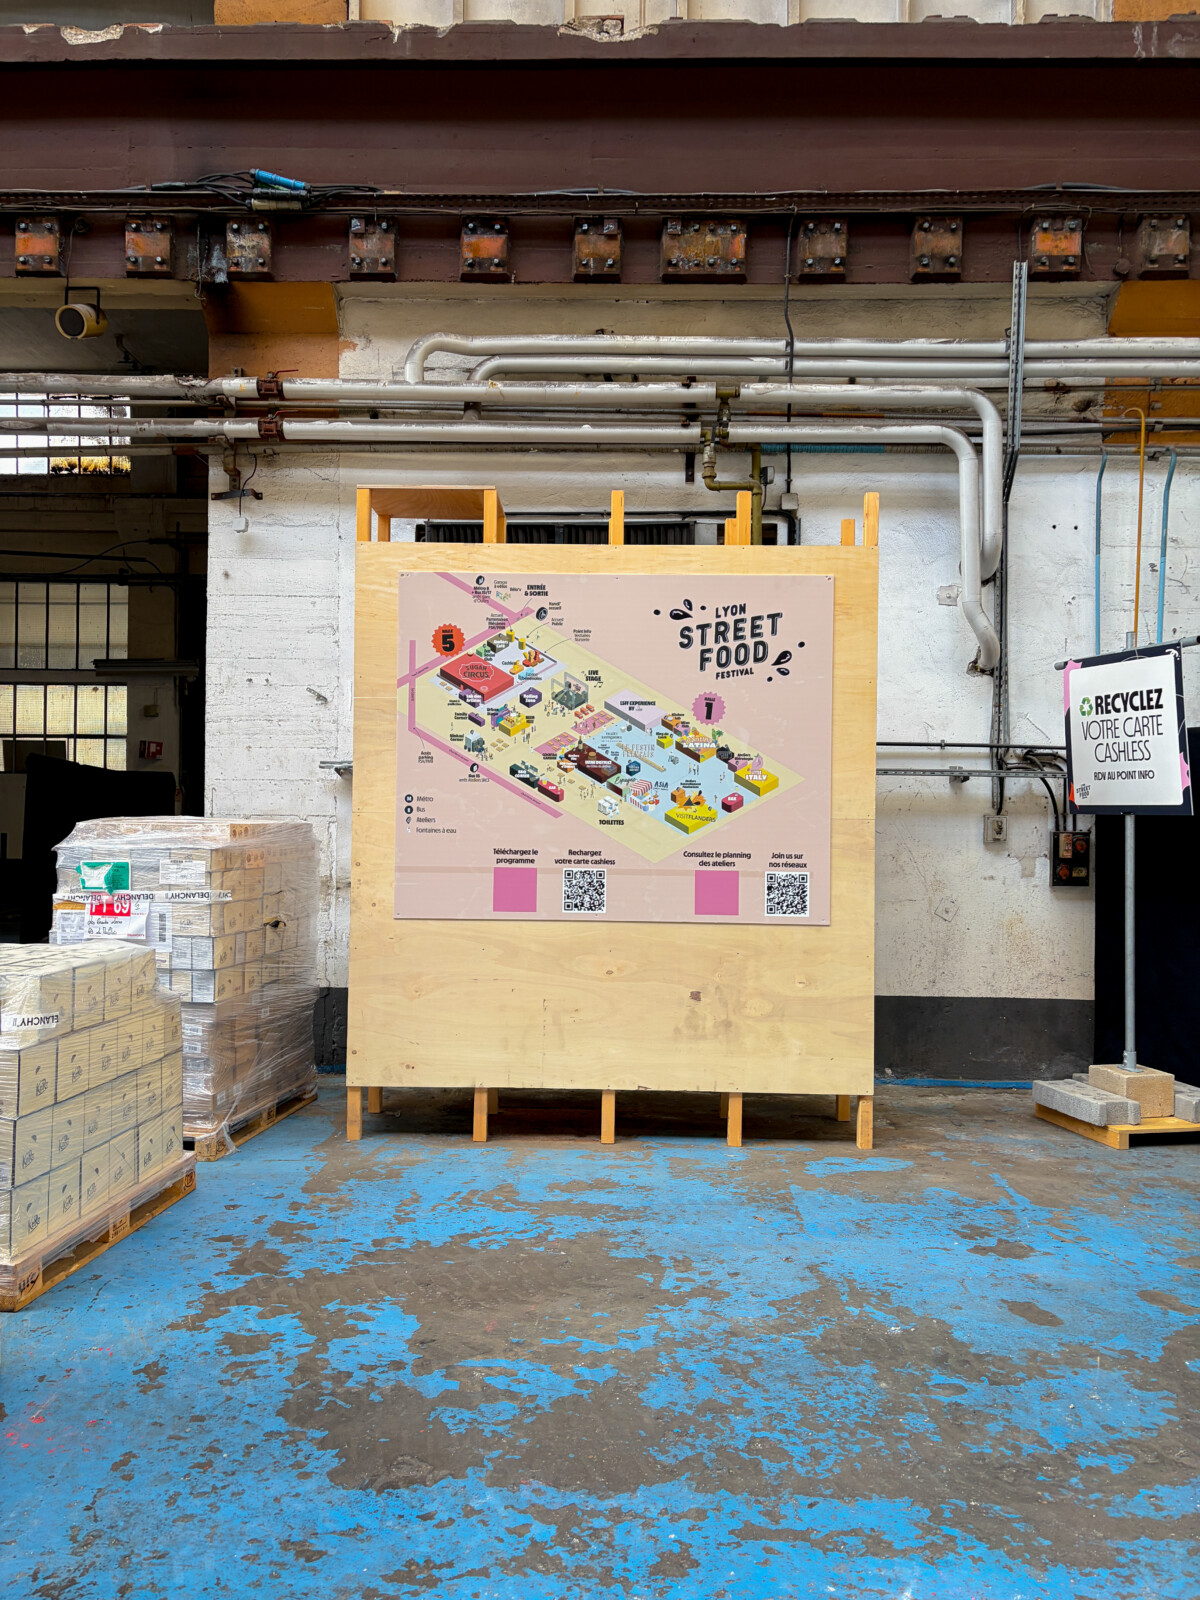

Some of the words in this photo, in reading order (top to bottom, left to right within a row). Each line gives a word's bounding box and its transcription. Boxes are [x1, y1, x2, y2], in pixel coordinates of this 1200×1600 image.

[715, 603, 746, 618] LYON
[679, 612, 783, 649] STREET
[442, 634, 455, 652] 5
[699, 640, 769, 672] FOOD
[716, 668, 754, 680] FESTIVAL
[1095, 688, 1163, 715] RECYCLEZ
[705, 702, 713, 720] 1
[1082, 718, 1120, 740] VOTRE
[1123, 714, 1163, 737] CARTE
[1095, 740, 1151, 762] CASHLESS
[1094, 771, 1106, 780] RDV
[1107, 772, 1115, 780] AU
[1117, 770, 1136, 780] POINT
[1138, 770, 1155, 779] INFO
[676, 813, 717, 823] VISITFLANDERS
[493, 848, 531, 856] Téléchargez
[568, 849, 602, 857] Rechargez
[170, 892, 209, 900] DELANCHY
[113, 896, 129, 913] 69
[20, 1015, 59, 1028] ELANCHY
